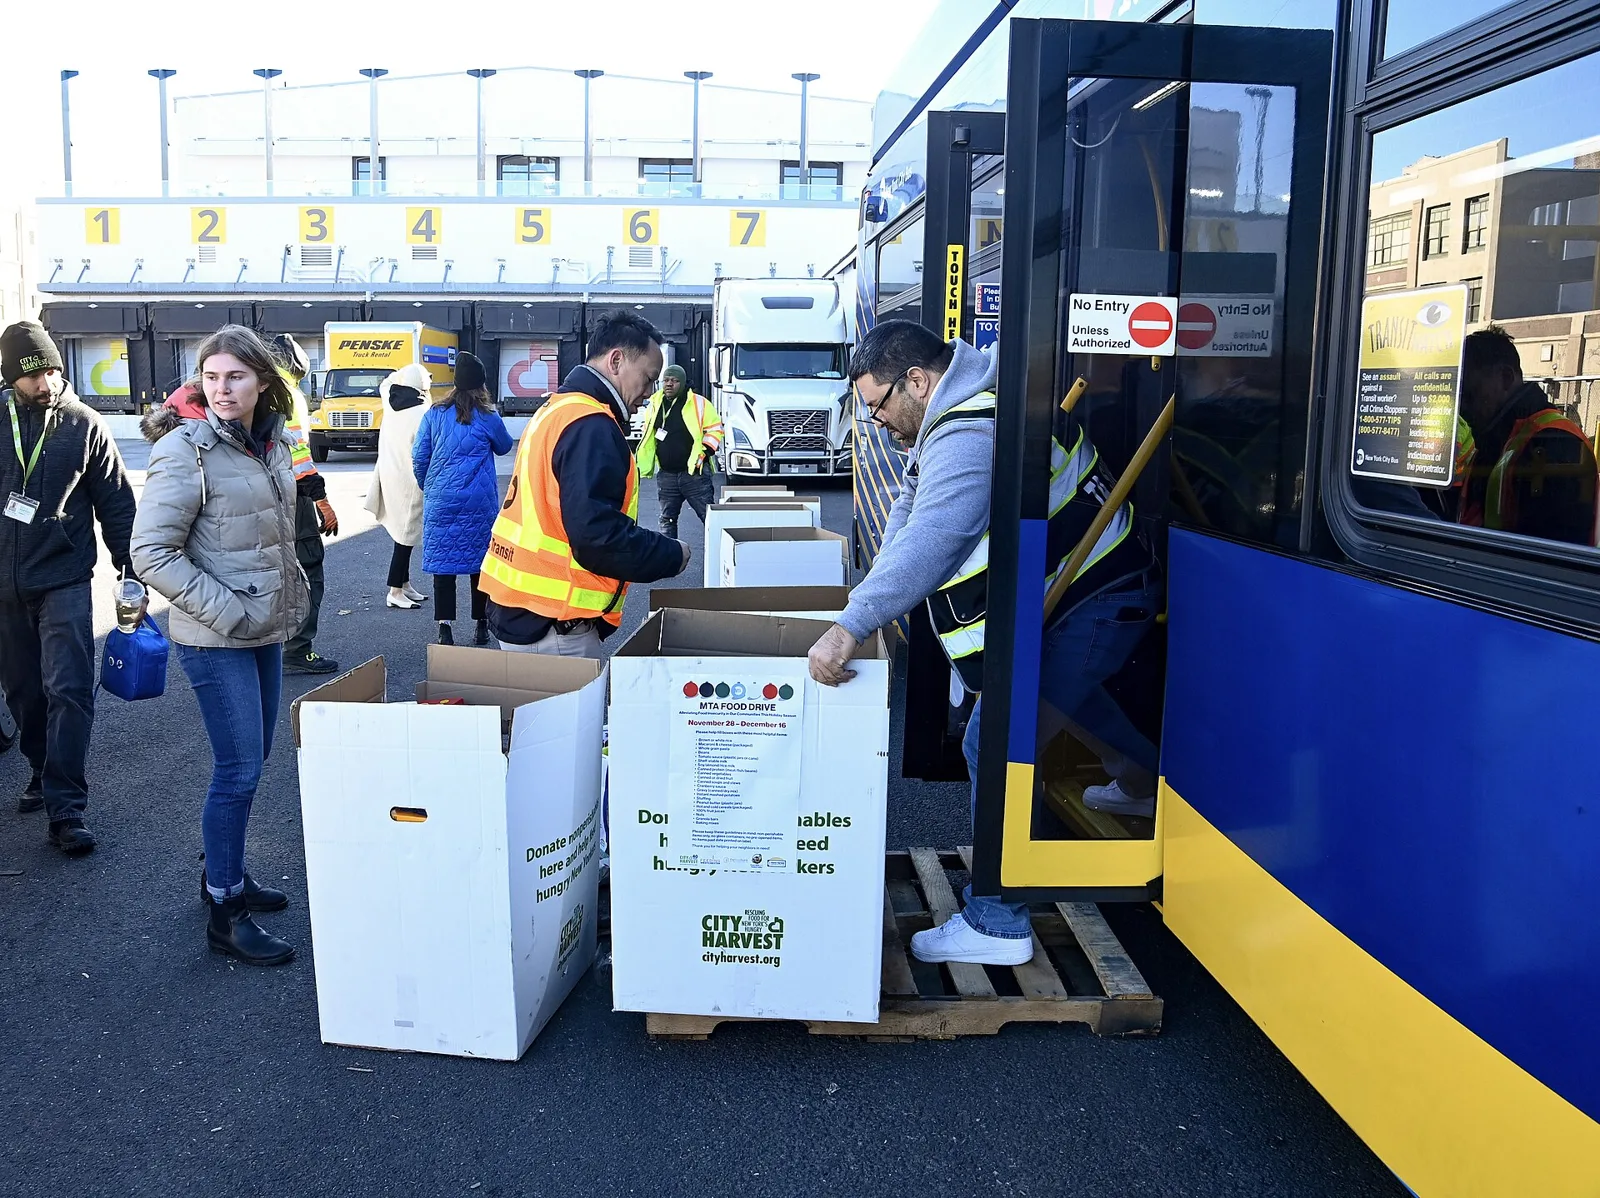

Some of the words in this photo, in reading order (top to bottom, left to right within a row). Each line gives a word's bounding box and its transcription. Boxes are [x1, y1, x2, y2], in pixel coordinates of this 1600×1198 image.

[94, 210, 109, 242] 1
[198, 210, 220, 242] 2
[306, 209, 328, 241] 3
[412, 210, 436, 242] 4
[522, 210, 544, 242] 5
[630, 211, 652, 243] 6
[737, 212, 760, 244] 7
[949, 252, 959, 310] TOUCH
[1074, 299, 1091, 310] No
[1095, 300, 1129, 314] Entry
[948, 318, 956, 339] HE
[979, 322, 992, 331] TO
[1072, 326, 1109, 335] Unless
[1368, 316, 1418, 353] TRANSIT
[338, 340, 404, 350] PENSKE
[1072, 338, 1130, 348] Authorized
[20, 356, 32, 364] CITY
[1413, 383, 1452, 391] confidential.
[1370, 405, 1383, 413] Crime
[1412, 395, 1420, 404] Up
[491, 538, 514, 562] Transit
[526, 838, 566, 862] Donate
[797, 836, 828, 850] eed
[540, 860, 563, 879] here
[566, 846, 577, 867] and
[797, 859, 834, 874] kers
[537, 876, 570, 903] hungry
[571, 863, 582, 882] New
[702, 915, 742, 931] CITY
[702, 932, 783, 949] HARVEST
[702, 951, 780, 967] cityharvest.org
